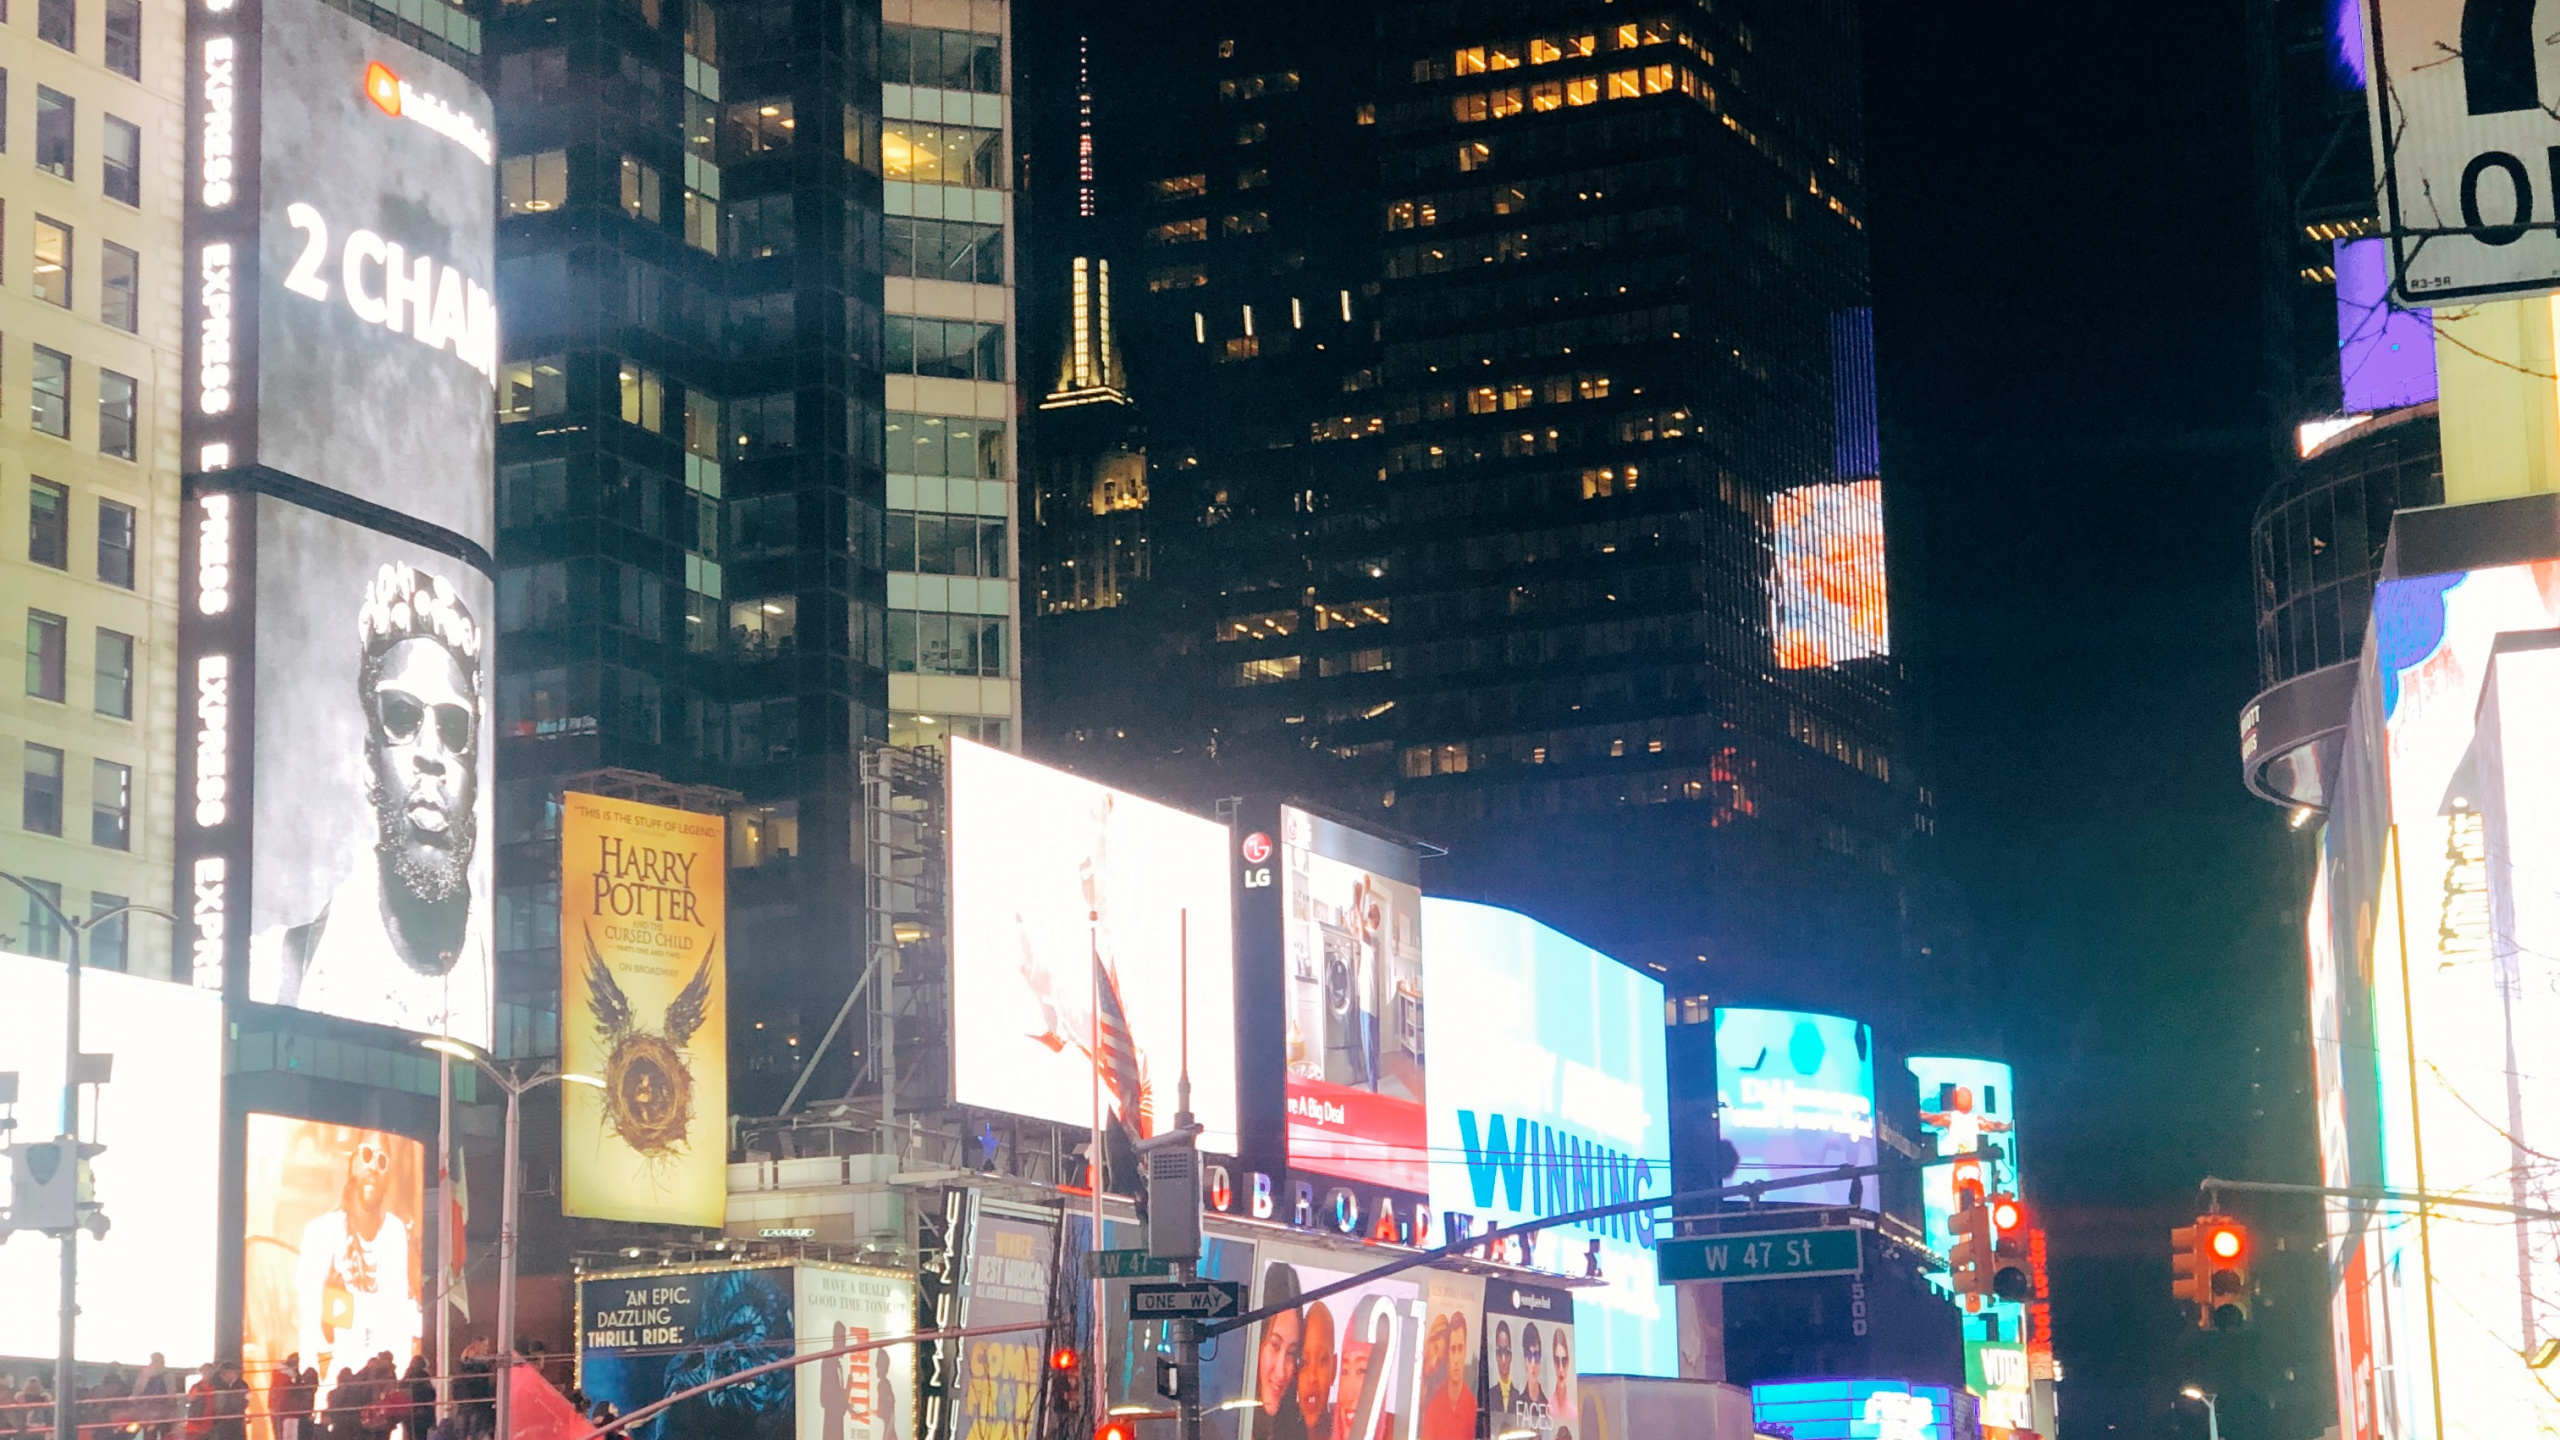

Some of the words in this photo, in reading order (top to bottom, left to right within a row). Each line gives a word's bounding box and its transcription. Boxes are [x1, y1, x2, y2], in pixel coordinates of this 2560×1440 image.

[203, 37, 233, 207] EXPRESS
[284, 203, 328, 301] 2
[201, 243, 231, 414] EXPRESS
[196, 655, 227, 827] EXPRESS
[603, 811, 612, 821] IS
[614, 812, 632, 825] THE
[634, 815, 662, 830] STUFF
[664, 819, 677, 832] OF
[598, 834, 698, 889] HARRY
[1245, 868, 1271, 888] LG
[592, 873, 706, 928] POTTER
[633, 920, 648, 930] AND
[650, 922, 664, 932] THE
[604, 925, 652, 945] CURSED
[655, 933, 694, 950] CHILD
[651, 949, 664, 957] AND
[619, 962, 632, 972] ON
[634, 964, 679, 977] BROADWAY
[1299, 1095, 1308, 1116] A
[1308, 1097, 1324, 1126] Big
[1324, 1101, 1345, 1125] Deal
[1457, 1109, 1656, 1251] WINNING
[763, 1229, 810, 1238] LAMAR
[1105, 1254, 1120, 1275] W
[1129, 1253, 1149, 1273] 47
[1705, 1245, 1728, 1271] W
[1743, 1241, 1773, 1269] 47
[1787, 1238, 1813, 1267] St
[652, 1287, 691, 1305] EPIC,
[822, 1277, 846, 1293] HAVE
[850, 1281, 855, 1293] A
[859, 1282, 891, 1297] REALLY
[808, 1294, 836, 1309] GOOD
[840, 1296, 861, 1312] TIME
[1145, 1294, 1176, 1309] ONE
[1190, 1293, 1223, 1308] WAY
[597, 1308, 672, 1328] DAZZLING
[588, 1329, 639, 1348] THRILL
[971, 1341, 1039, 1383] COME
[1515, 1400, 1554, 1431] FACES
